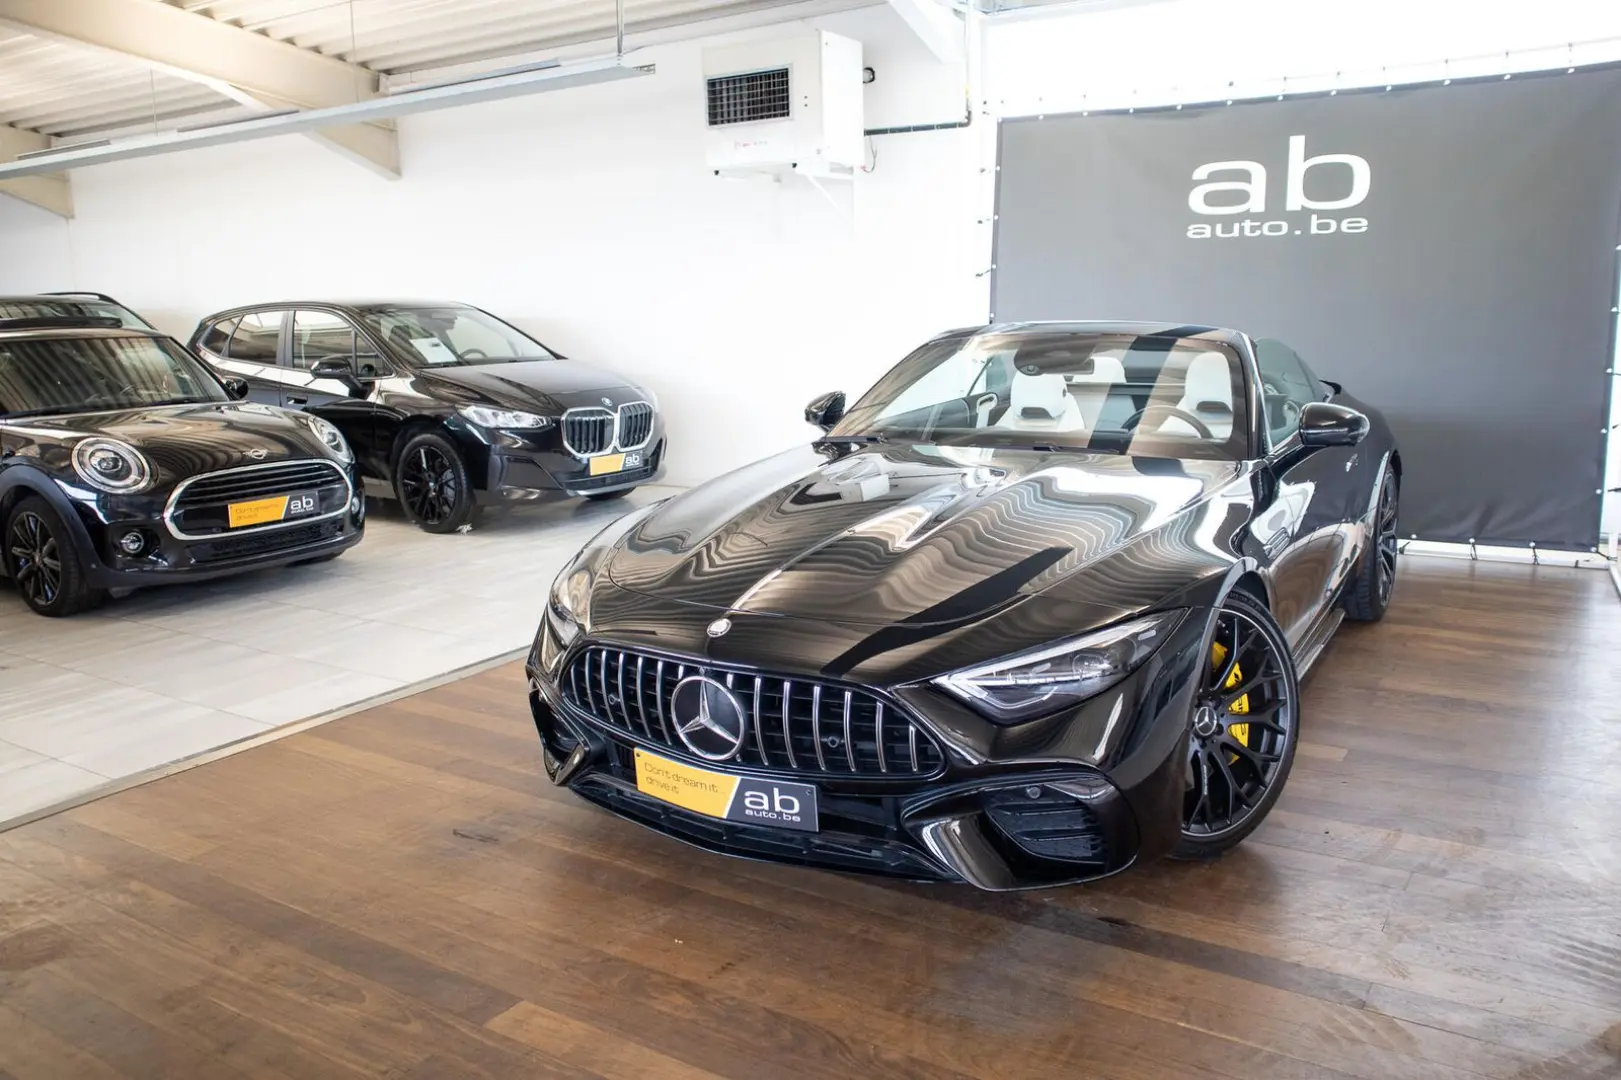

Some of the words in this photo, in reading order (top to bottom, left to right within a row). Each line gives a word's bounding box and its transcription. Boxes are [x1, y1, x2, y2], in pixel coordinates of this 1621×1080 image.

[1188, 134, 1371, 215] ab
[1186, 214, 1369, 239] auto.be
[290, 496, 314, 510] ab
[672, 773, 707, 791] dream
[744, 787, 800, 814] ab
[745, 809, 801, 822] auto.be
